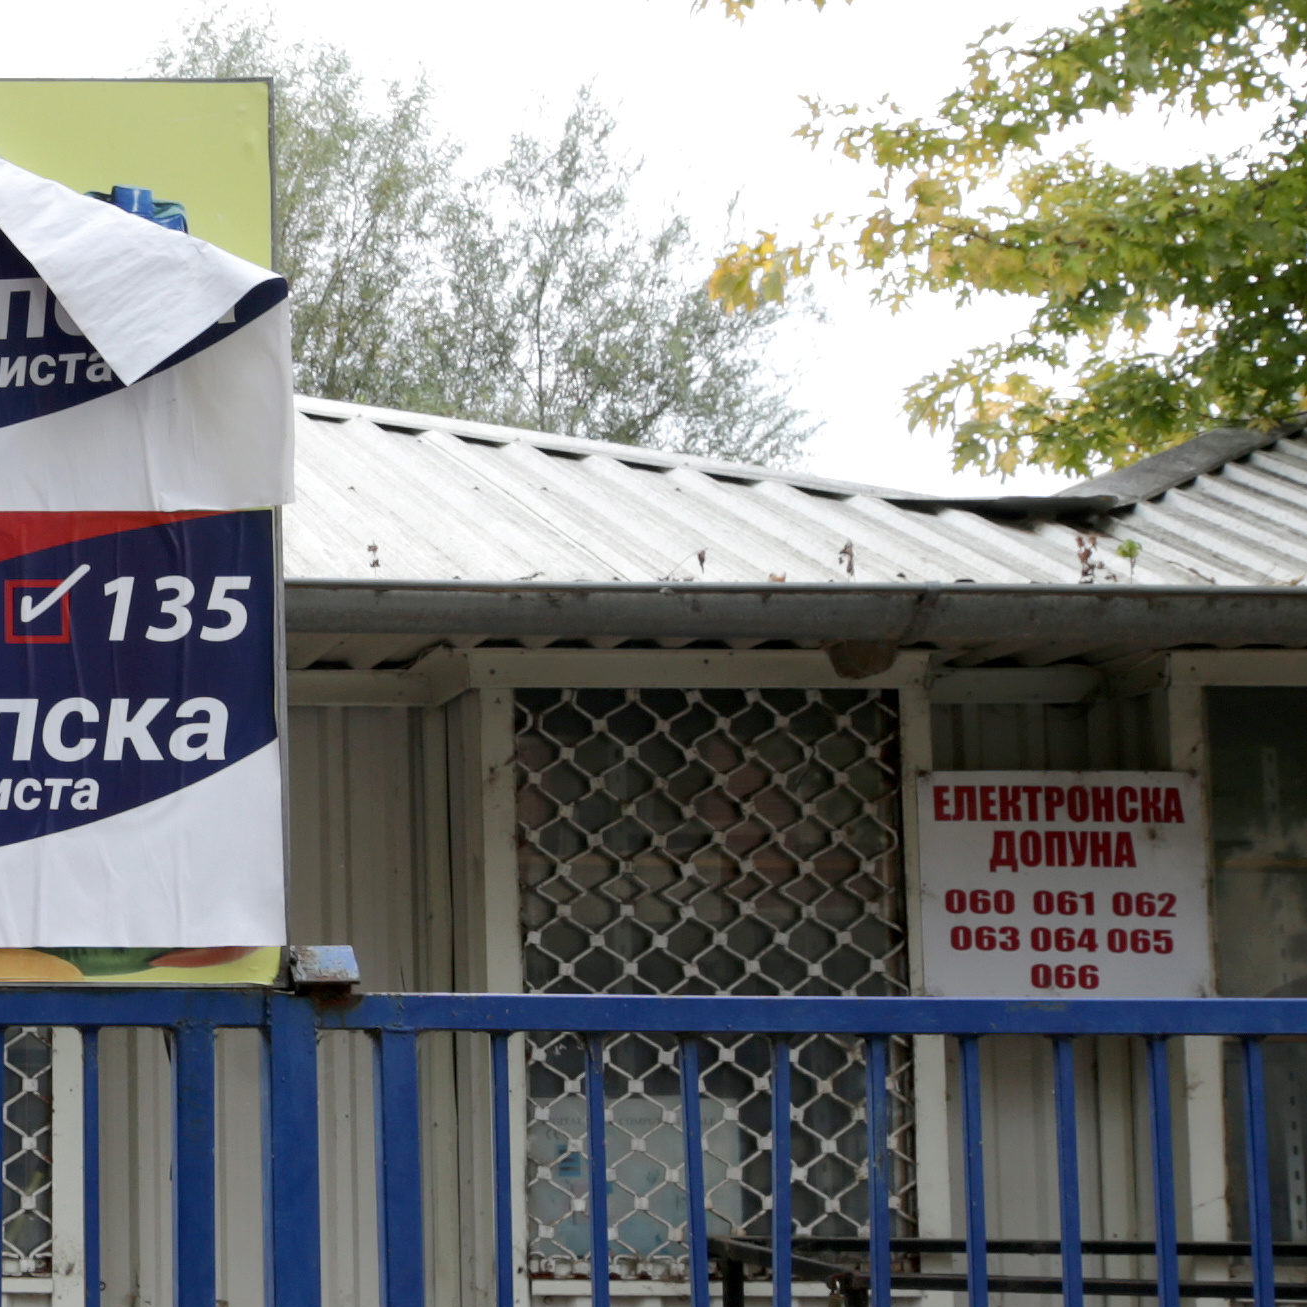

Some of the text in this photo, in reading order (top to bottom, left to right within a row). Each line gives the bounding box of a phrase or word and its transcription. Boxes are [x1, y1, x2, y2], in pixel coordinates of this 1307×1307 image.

[103, 575, 251, 643] 135
[933, 785, 1184, 823] ЕЛЕКТРОНСКА
[989, 831, 1136, 873] ДОПУНА
[944, 889, 1177, 918] 060 061 062
[950, 926, 1173, 954] 063 064 065
[1030, 964, 1099, 990] 066
